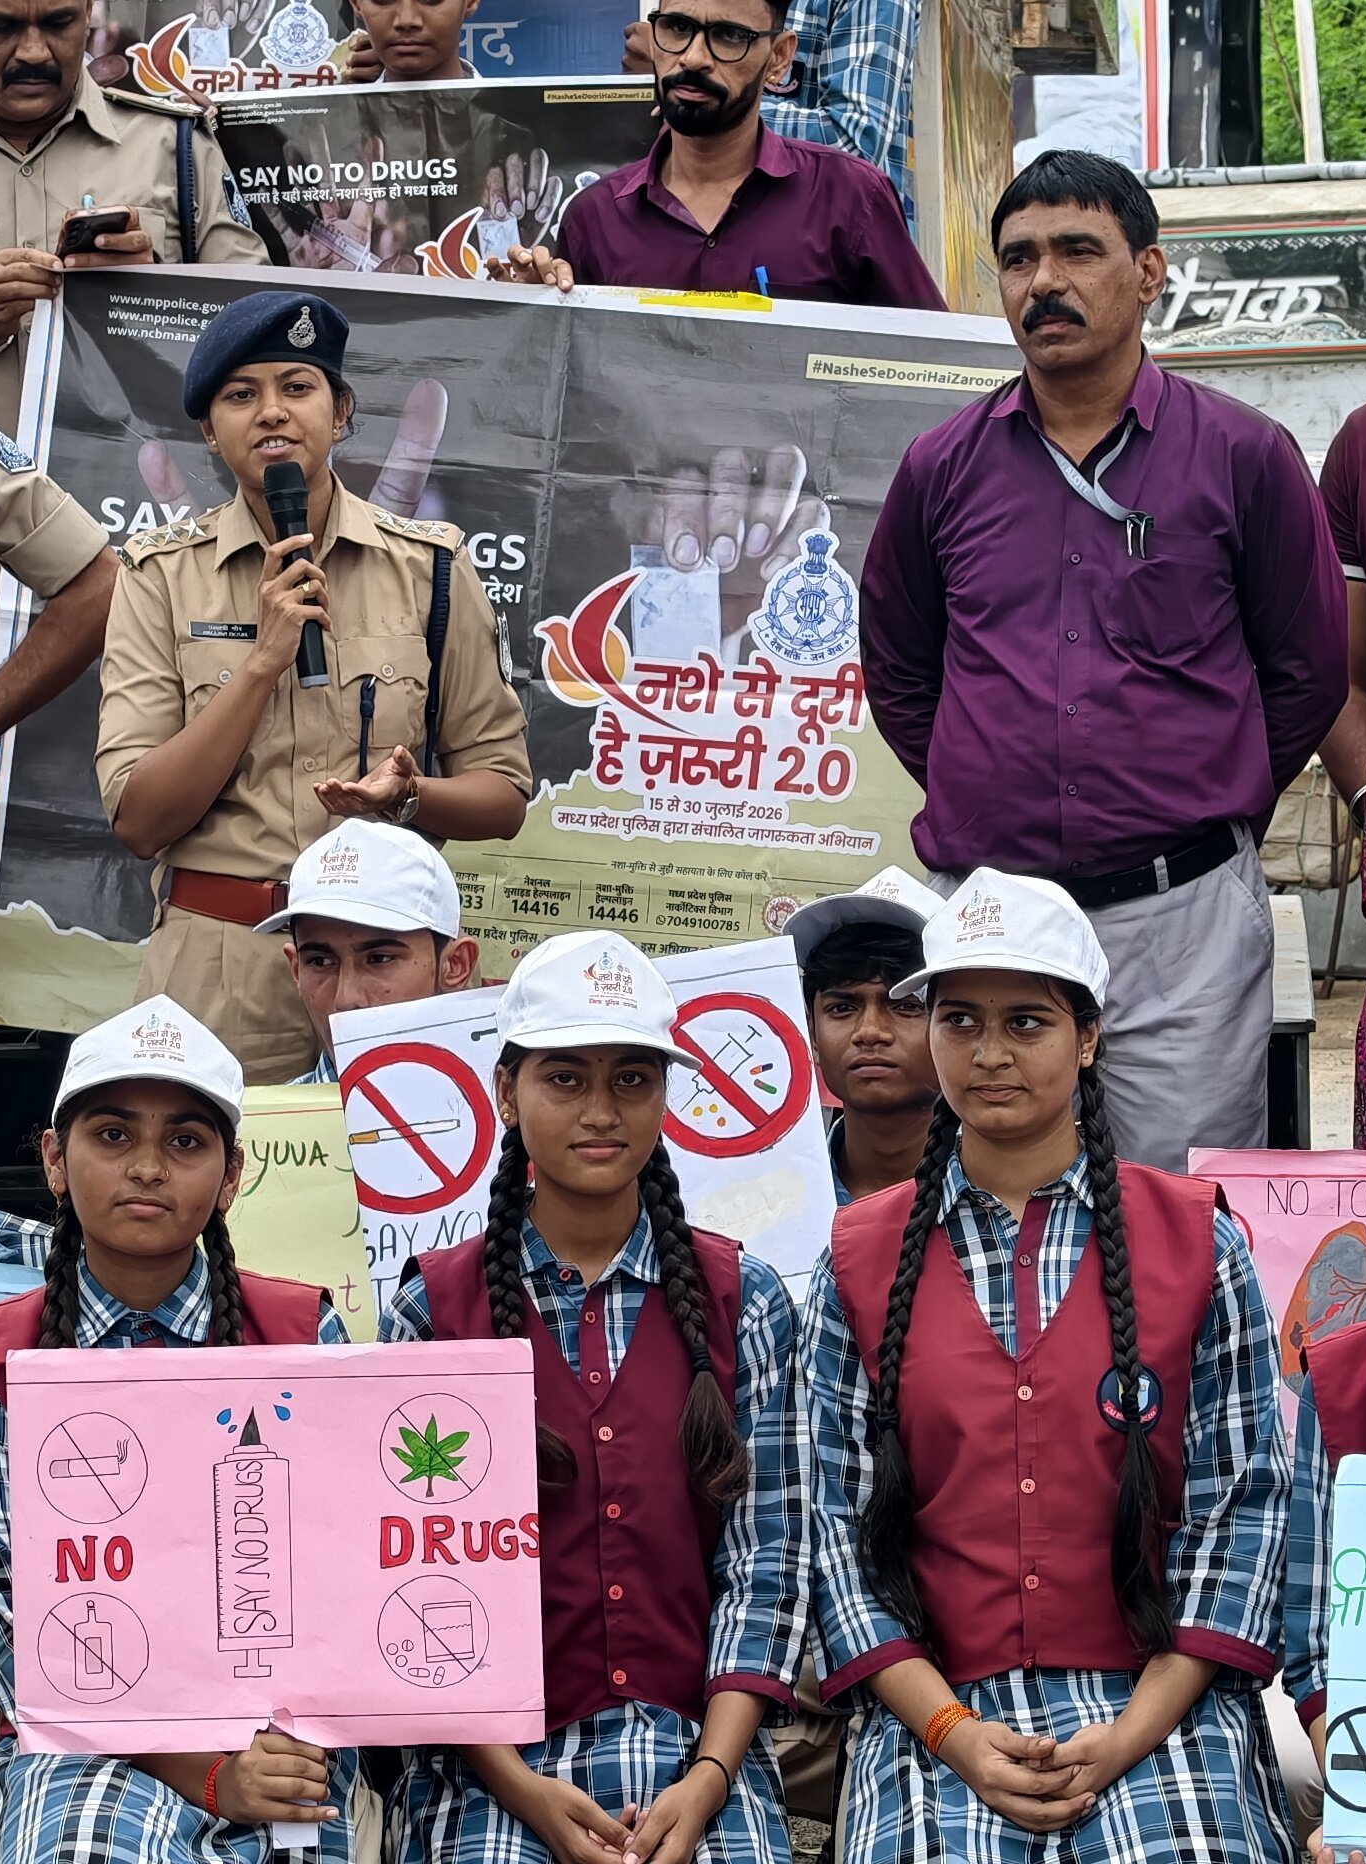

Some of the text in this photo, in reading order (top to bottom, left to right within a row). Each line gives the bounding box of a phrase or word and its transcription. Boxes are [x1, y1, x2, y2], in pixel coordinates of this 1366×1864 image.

[239, 158, 458, 188] SAY NO TO DRUGS
[389, 183, 401, 199] हो
[403, 185, 428, 198] मध्य
[431, 181, 458, 197] प्रदेश
[109, 294, 231, 314] www.mppolice.gov
[108, 309, 212, 330] www.mppolice.g
[635, 652, 865, 745] नशे से दूरी
[595, 711, 851, 797] है ज़रूरी 2.0
[650, 795, 783, 821] 15 से 30 जुलाई 2026
[557, 812, 586, 827] मध्य
[589, 811, 619, 829] प्रदेश
[623, 814, 660, 835] पुलिस
[663, 820, 688, 838] द्वारा
[690, 819, 745, 840] संचालित
[818, 830, 874, 851] अभियान
[611, 860, 646, 873] नशा-मुक्ति
[649, 861, 656, 873] से
[717, 867, 733, 879] लिए
[523, 875, 550, 888] नेशनल
[595, 883, 634, 895] नशा-मुक्ति
[533, 887, 571, 901] हेल्पलाइन
[595, 893, 633, 906] हेल्पलाइन
[668, 889, 732, 903] मध्य प्रदेश पुलिस
[512, 899, 560, 916] 14416
[588, 905, 639, 923] 14446
[709, 902, 733, 916] विभाग
[484, 926, 507, 940] प्रदेश
[667, 916, 740, 932] 7049100785
[242, 1140, 329, 1197] YUVA
[1267, 1180, 1309, 1215] NO
[379, 1513, 540, 1569] DRUGS
[55, 1535, 134, 1583] NO
[233, 1578, 277, 1634] SAY
